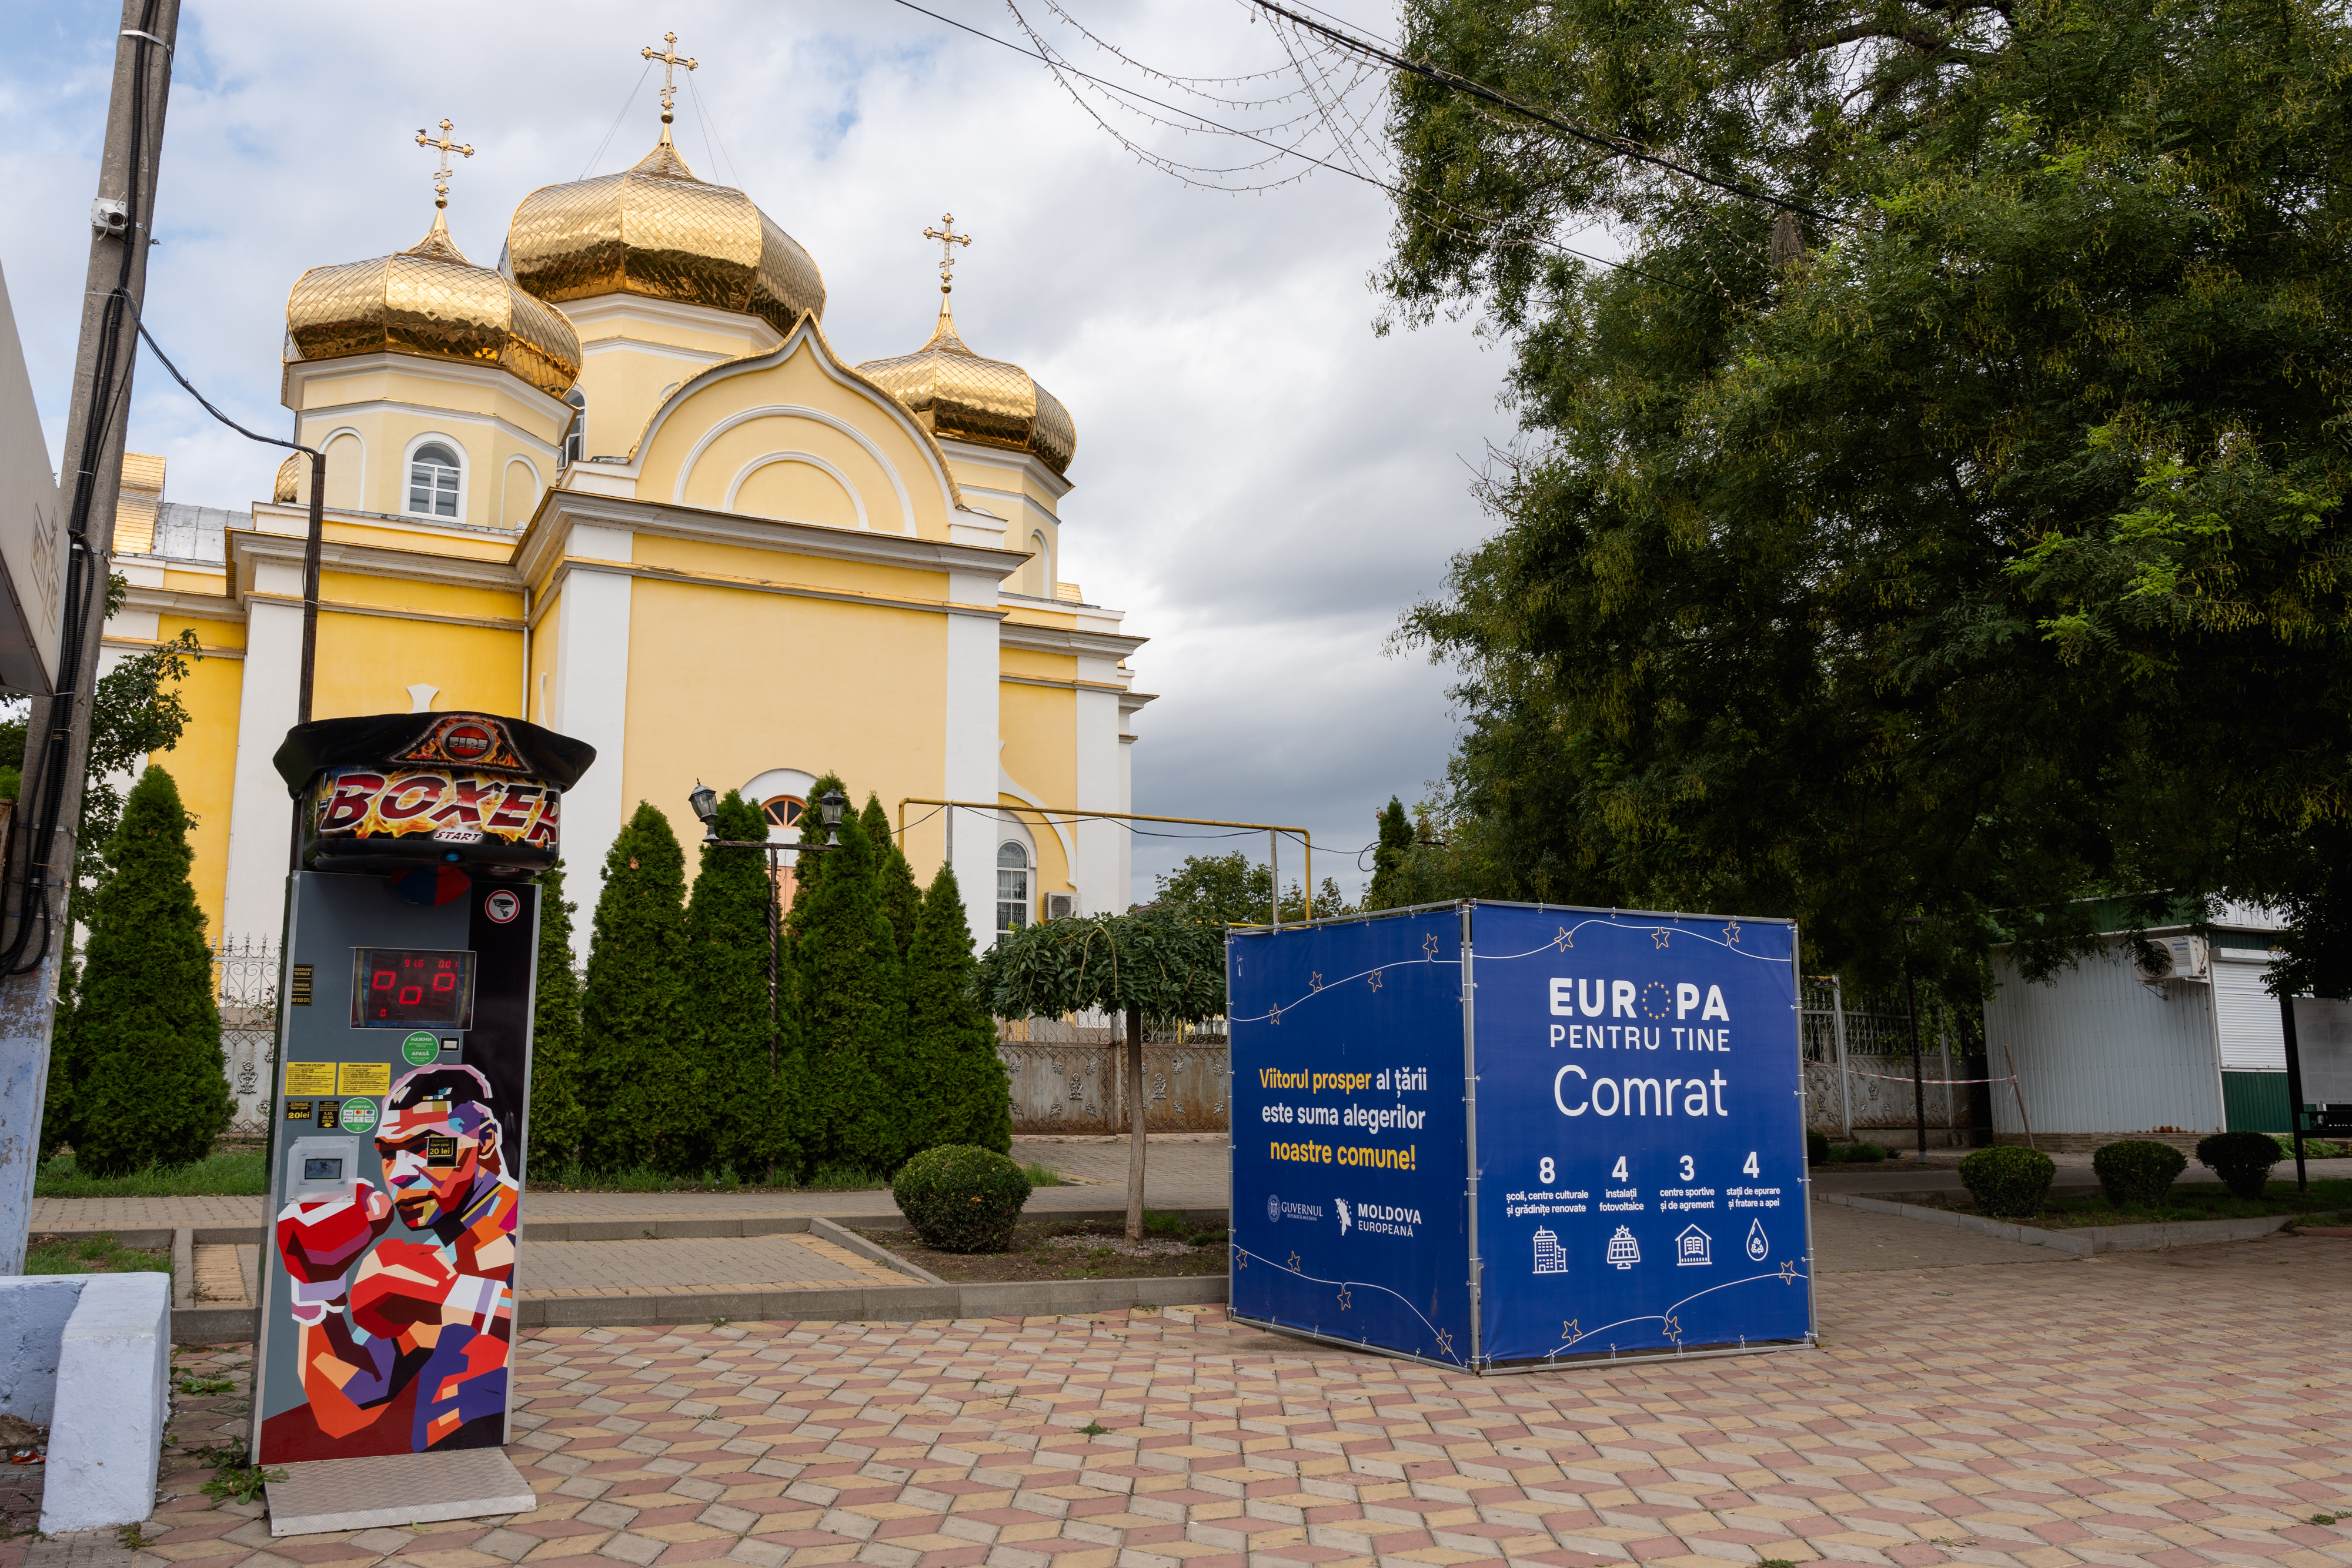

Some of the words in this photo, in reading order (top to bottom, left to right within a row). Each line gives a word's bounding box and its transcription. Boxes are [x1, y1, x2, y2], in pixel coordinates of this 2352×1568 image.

[449, 737, 488, 750] FIRE
[319, 772, 560, 844] BOXER
[434, 831, 483, 841] START
[1550, 1024, 1660, 1050] PENTRU
[1671, 1027, 1730, 1052] TINE
[1259, 1067, 1308, 1089] Viitorul
[1312, 1072, 1372, 1095] prosper
[1376, 1068, 1390, 1090] al
[1394, 1066, 1427, 1098] țării
[1554, 1064, 1728, 1116] Comrat
[1262, 1102, 1293, 1124] este
[1297, 1106, 1339, 1125] suma
[1344, 1103, 1426, 1135] alegerilor
[1271, 1139, 1332, 1164] noastre
[1337, 1144, 1416, 1171] comune!
[1742, 1151, 1760, 1178] 4
[1539, 1156, 1555, 1183] 8
[1612, 1156, 1629, 1182] 4
[1679, 1155, 1695, 1181] 3
[1528, 1191, 1553, 1200] centre
[1555, 1189, 1589, 1199] culturale
[1660, 1188, 1683, 1196] centre
[1685, 1186, 1715, 1198] sportive
[1744, 1187, 1753, 1195] de
[1754, 1188, 1780, 1196] epurare
[1281, 1202, 1324, 1217] GUVERNUL
[1552, 1203, 1586, 1213] renovate
[1599, 1201, 1644, 1211] fotovoltaice
[1668, 1201, 1678, 1209] de
[1679, 1200, 1715, 1211] agrement
[1765, 1198, 1779, 1208] apei
[1358, 1203, 1422, 1225] MOLDOVA
[1358, 1219, 1414, 1237] EUROPEANĂ
